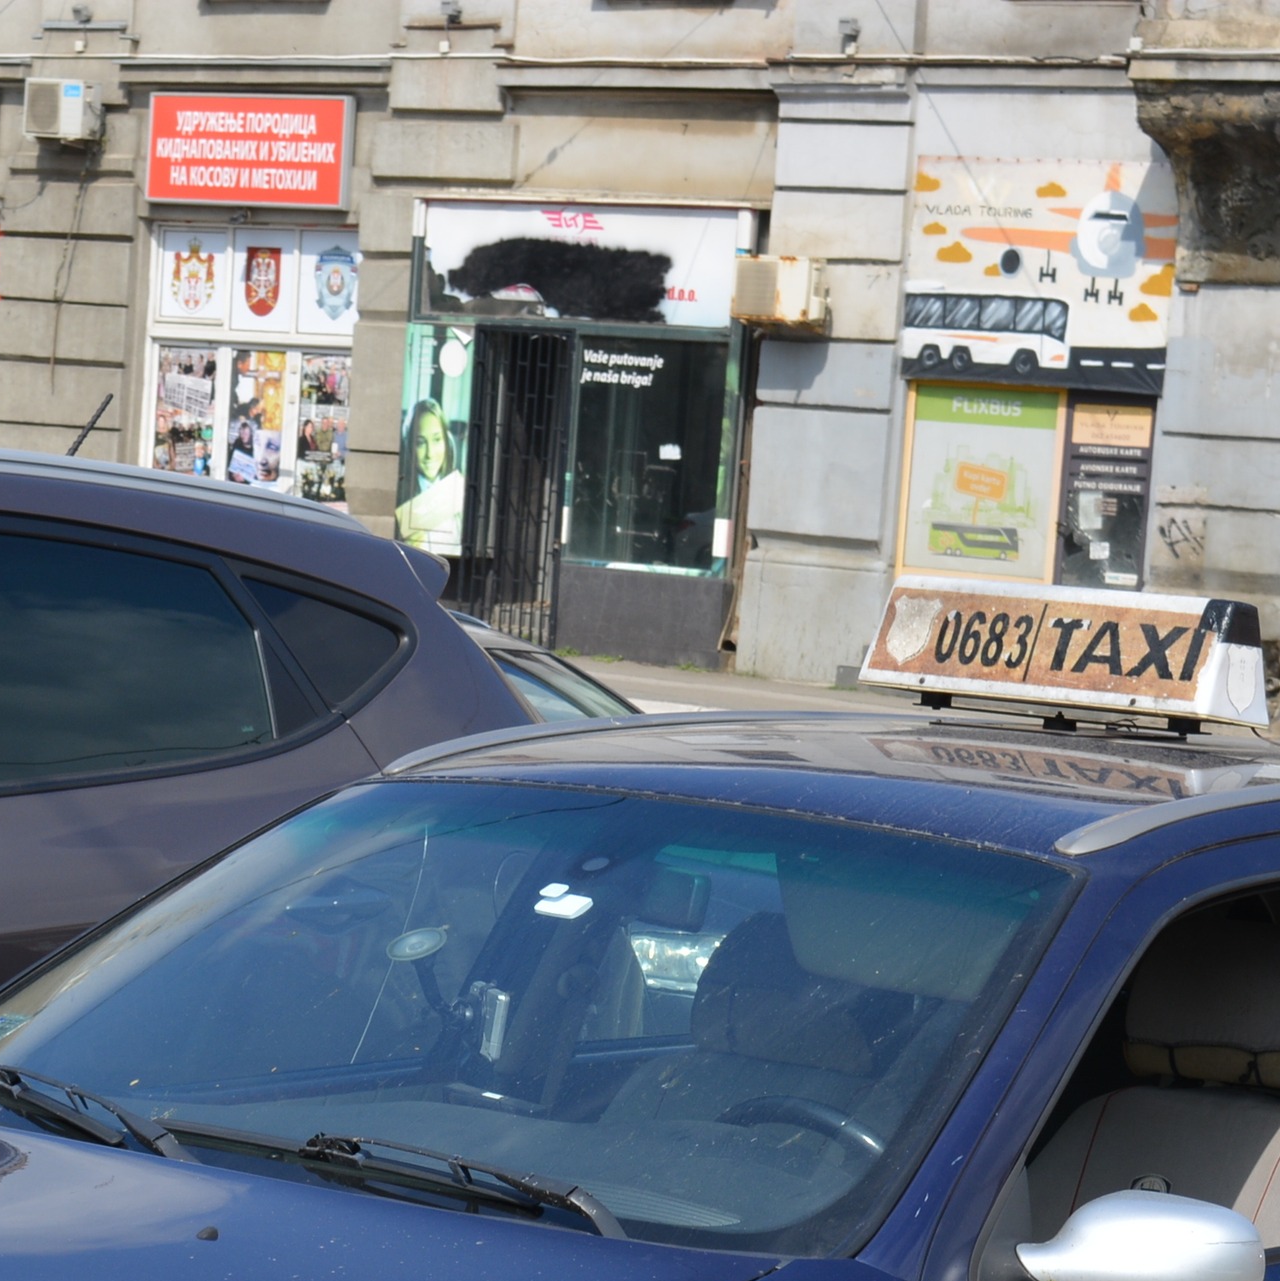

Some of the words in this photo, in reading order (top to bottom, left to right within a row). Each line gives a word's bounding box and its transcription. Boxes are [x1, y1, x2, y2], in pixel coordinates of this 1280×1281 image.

[177, 111, 244, 134] УДРУЖЕЊЕ
[246, 114, 316, 138] ПОРОДИЦА
[156, 138, 256, 162] КИДНАПОВАНИХ
[260, 143, 268, 160] И
[270, 143, 335, 163] УБИЈЕНИХ
[171, 166, 187, 185] НА
[189, 167, 238, 188] КОСОВУ
[240, 170, 249, 187] И
[252, 169, 316, 191] МЕТОХИЈИ
[925, 204, 971, 216] VLADA
[979, 205, 1033, 219] TOURING
[584, 349, 607, 365] Vaše
[608, 354, 664, 370] putovanje
[580, 369, 592, 383] je
[593, 370, 619, 384] naša
[620, 373, 652, 388] briga!
[1120, 448, 1142, 457] KARTE
[1115, 465, 1137, 475] KARTE
[934, 610, 1032, 670] 0683
[1049, 617, 1206, 681] TAXI
